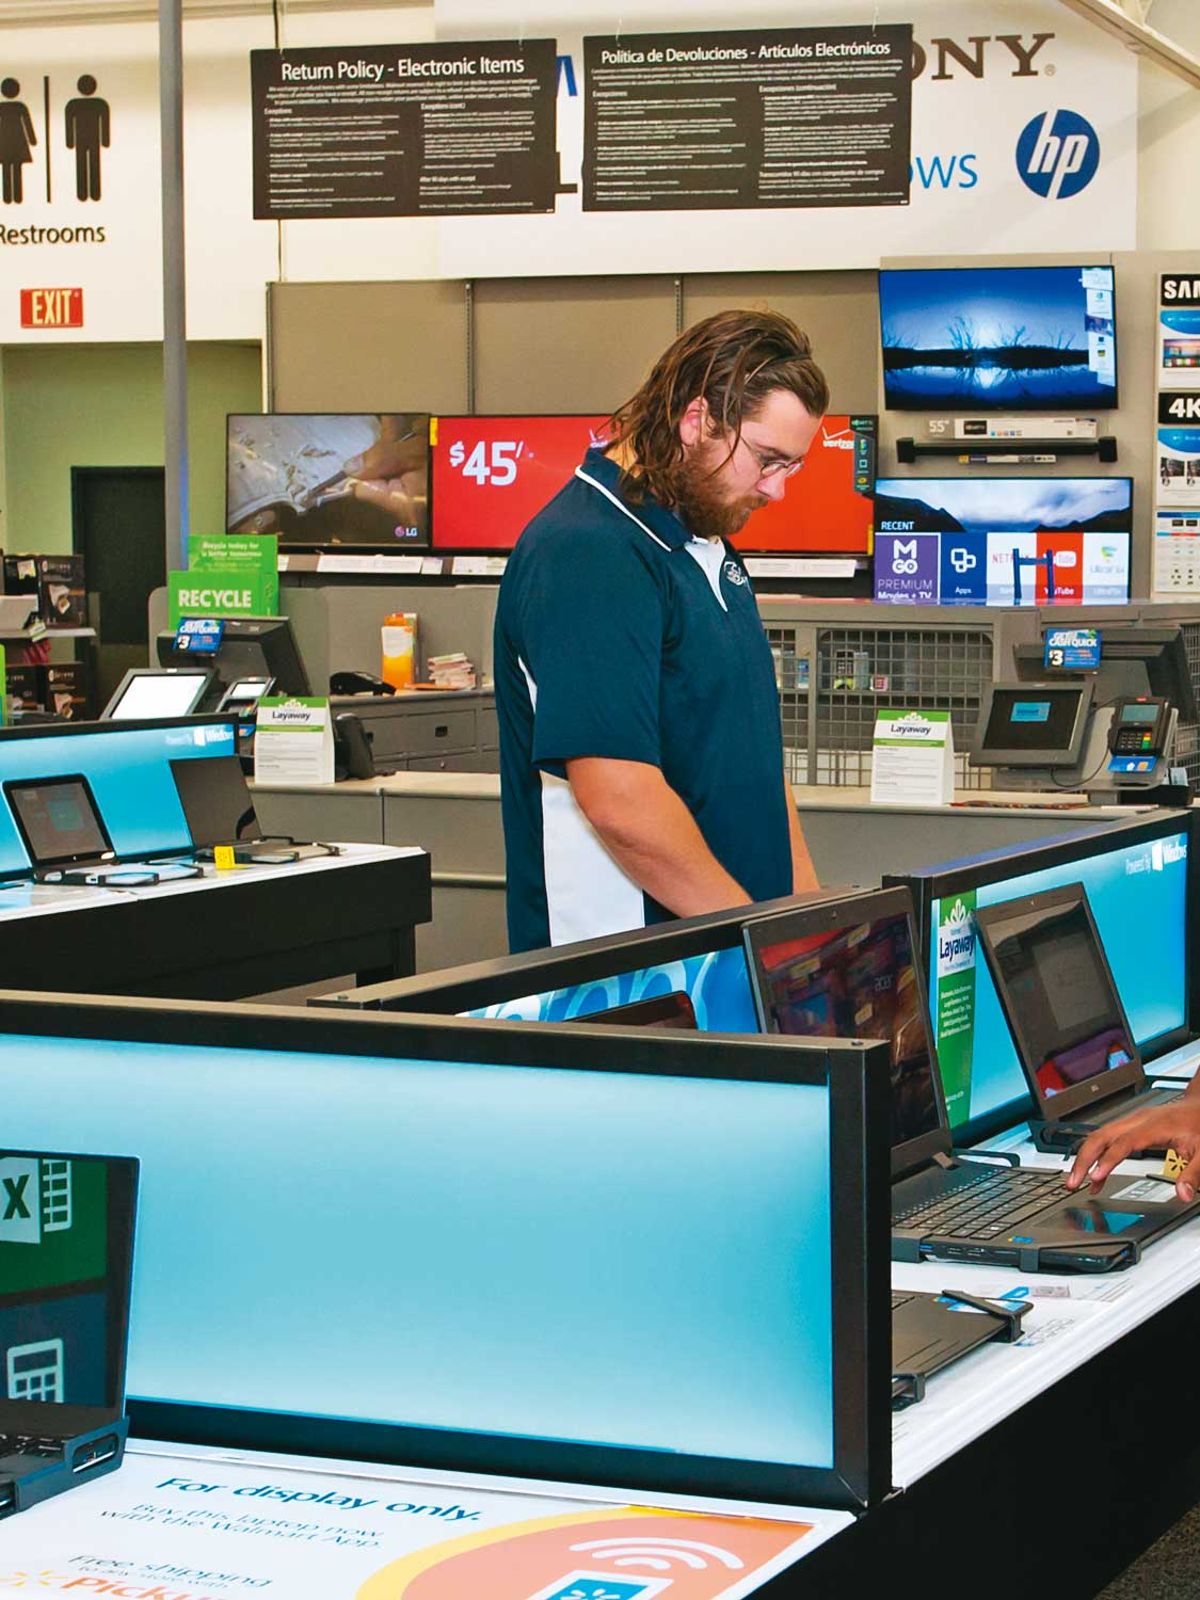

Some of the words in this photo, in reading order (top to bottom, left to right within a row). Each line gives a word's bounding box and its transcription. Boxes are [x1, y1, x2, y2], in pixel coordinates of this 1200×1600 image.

[648, 48, 663, 61] de
[666, 47, 748, 62] Devoluciones
[912, 33, 1055, 80] NY
[281, 61, 333, 81] Return
[338, 60, 384, 82] Policy
[398, 58, 477, 77] Electronic
[480, 57, 525, 75] Items
[1025, 109, 1091, 199] hp
[0, 224, 105, 245] Restrooms
[32, 290, 72, 325] EXIT
[405, 527, 417, 536] LG
[881, 521, 914, 530] RECENT
[878, 578, 933, 590] PREMIUM
[919, 590, 932, 599] TV
[955, 586, 971, 595] Apps
[178, 589, 252, 609] RECYCLE
[272, 711, 311, 720] Layaway
[890, 723, 932, 735] Layaway
[939, 935, 975, 962] Layaway
[156, 1477, 228, 1493] For
[233, 1485, 379, 1510] display
[385, 1503, 484, 1521] only.
[101, 1511, 155, 1521] with
[162, 1517, 204, 1527] the
[211, 1521, 318, 1540] Walmart
[321, 1536, 380, 1547] App
[133, 1504, 178, 1516] Buy
[186, 1510, 229, 1520] this
[236, 1513, 319, 1531] laptop
[326, 1526, 385, 1537] now
[68, 1555, 135, 1566] Free
[145, 1563, 273, 1587] shipping
